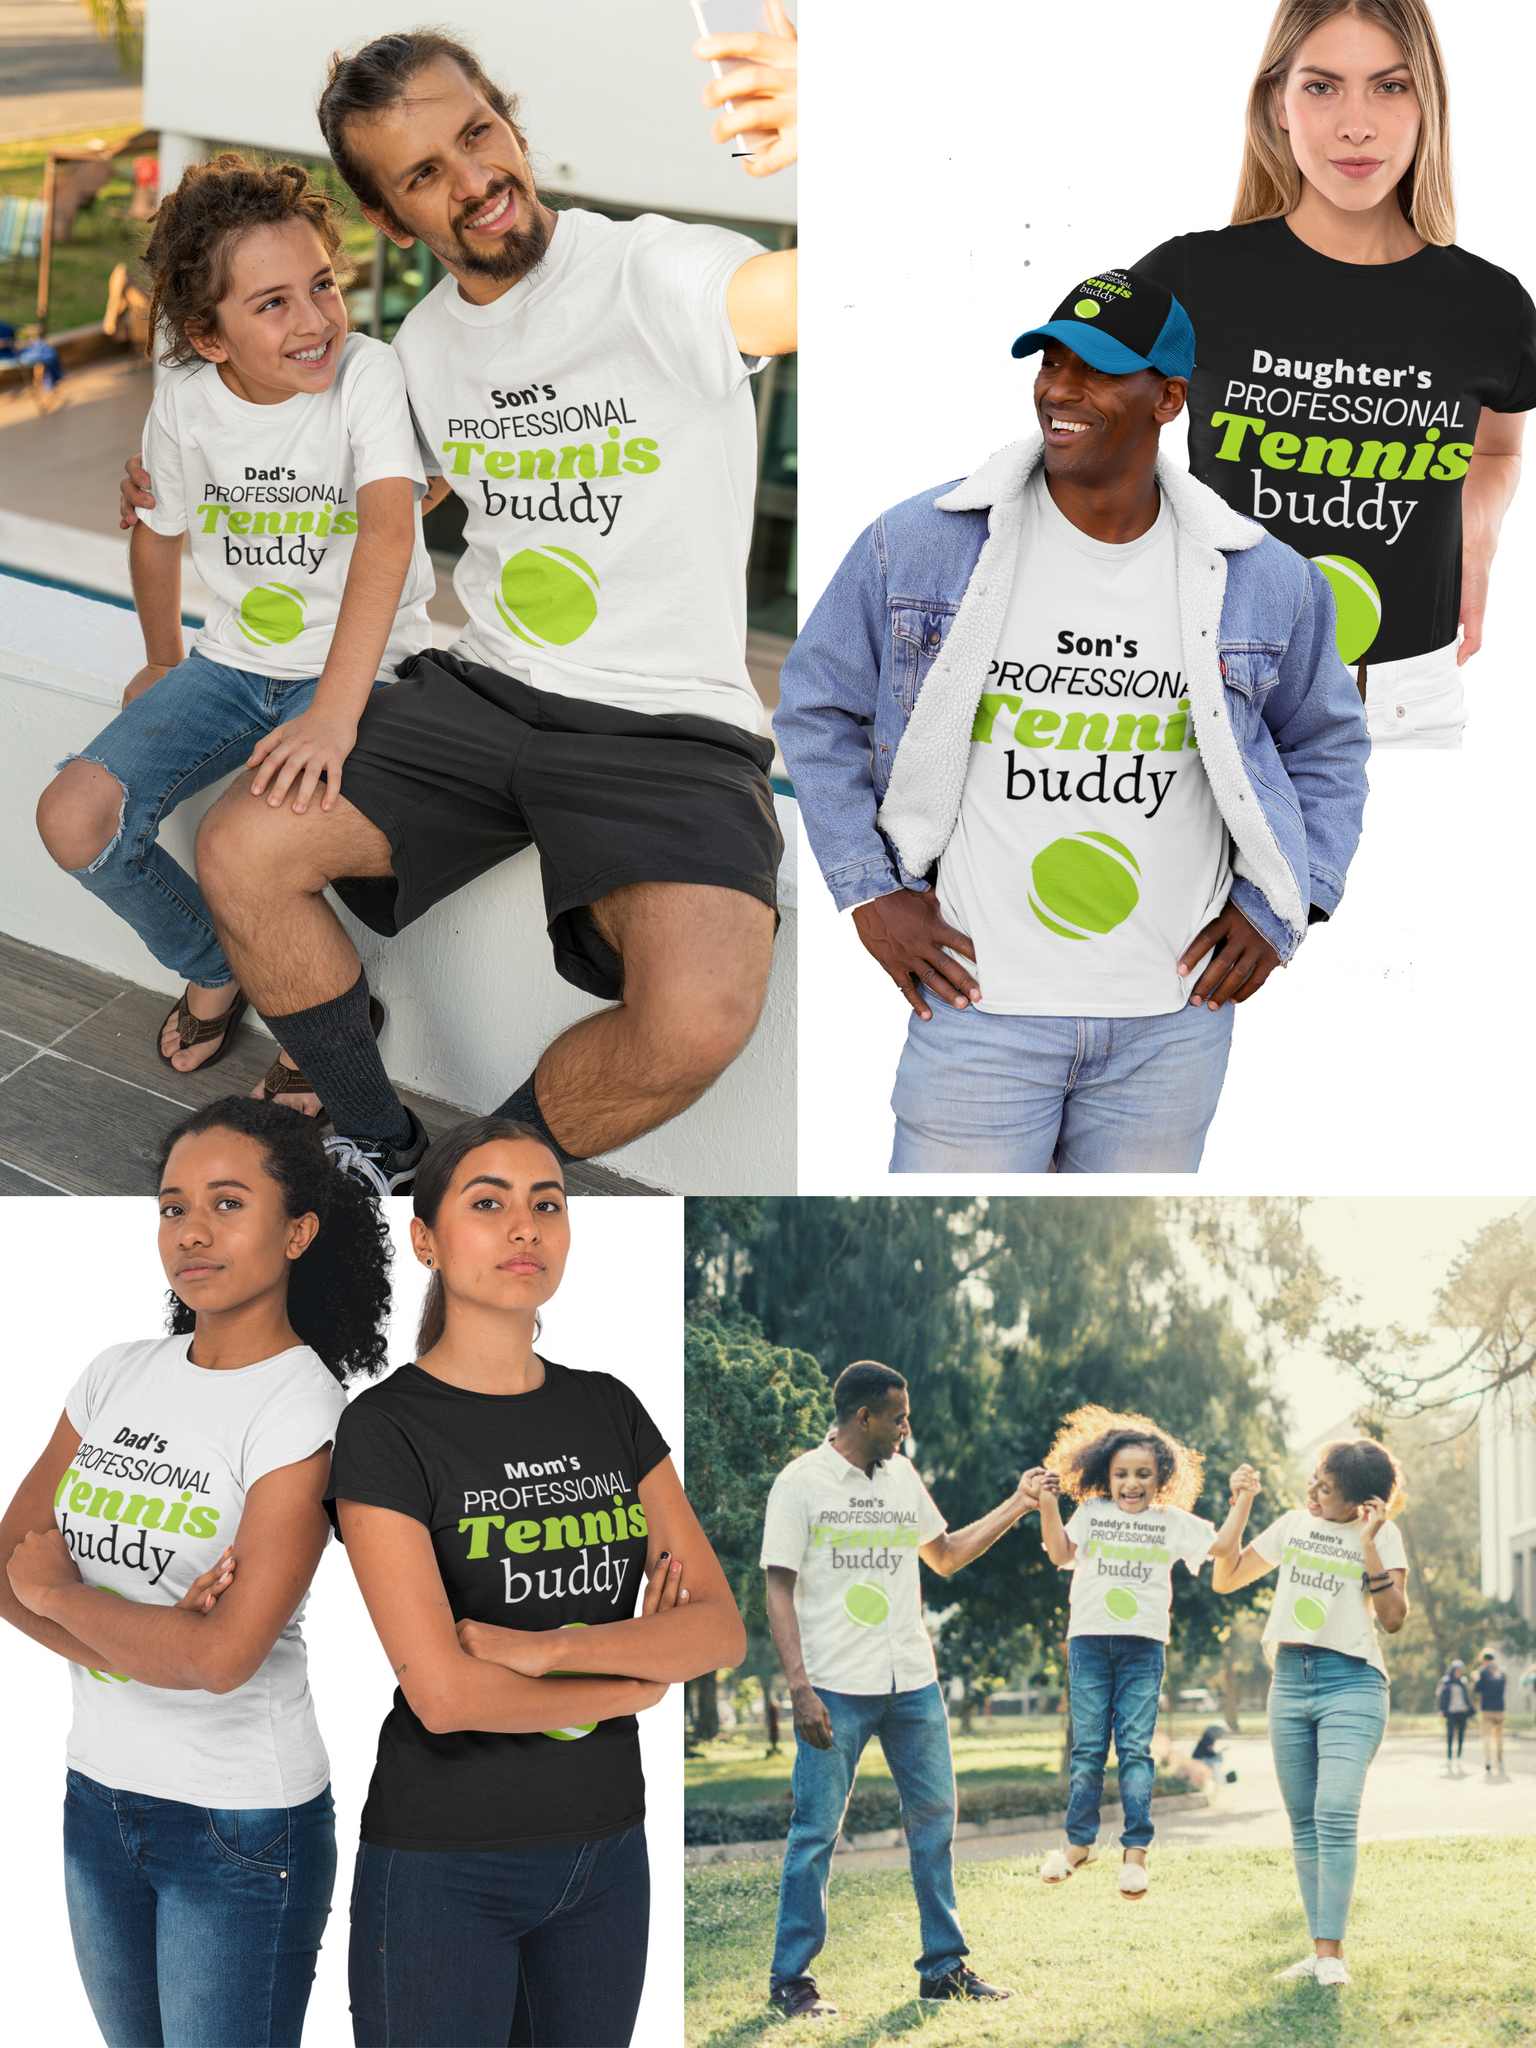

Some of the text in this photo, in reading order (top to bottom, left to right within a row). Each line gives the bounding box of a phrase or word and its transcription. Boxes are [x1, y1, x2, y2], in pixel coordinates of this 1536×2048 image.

[1080, 284, 1116, 303] buddy
[1083, 278, 1132, 299] ennis
[1253, 350, 1432, 389] Daughter's
[491, 384, 557, 409] Son's
[1225, 380, 1464, 428] PROFESSIONAL
[449, 398, 637, 440] PROFESSIONAL
[443, 426, 661, 480] Tennis
[1211, 410, 1474, 481] Tennis
[245, 467, 297, 481] Dad's
[204, 484, 348, 505] PROFESSIONAL
[480, 480, 623, 536] buddy
[1251, 469, 1418, 545] buddy
[197, 503, 359, 538] Tennis
[223, 535, 328, 575] buddy
[1057, 631, 1138, 659] Son's
[970, 693, 1200, 751] Tenni
[1004, 749, 1178, 819] buddy
[113, 1427, 169, 1454] Dad's
[76, 1443, 211, 1495] PROFESSIONAL
[504, 1455, 581, 1479] Mom's
[464, 1470, 632, 1514] PROFESSIONAL
[849, 1497, 884, 1508] Son's
[458, 1494, 649, 1559] Tennis
[820, 1511, 918, 1524] PROFESSIONAL
[1091, 1518, 1166, 1532] Daddy's future
[810, 1524, 920, 1547] Tennis
[1090, 1530, 1166, 1545] PROFESSIONAL
[1288, 1537, 1365, 1563] PROFESSIONAL
[1310, 1531, 1343, 1544] Mom's
[832, 1547, 903, 1576] buddy
[1086, 1540, 1171, 1563] Tennis
[1282, 1547, 1365, 1579] Tennis
[500, 1545, 630, 1605] buddy
[1098, 1558, 1152, 1583] buddy
[1290, 1566, 1345, 1597] buddy
